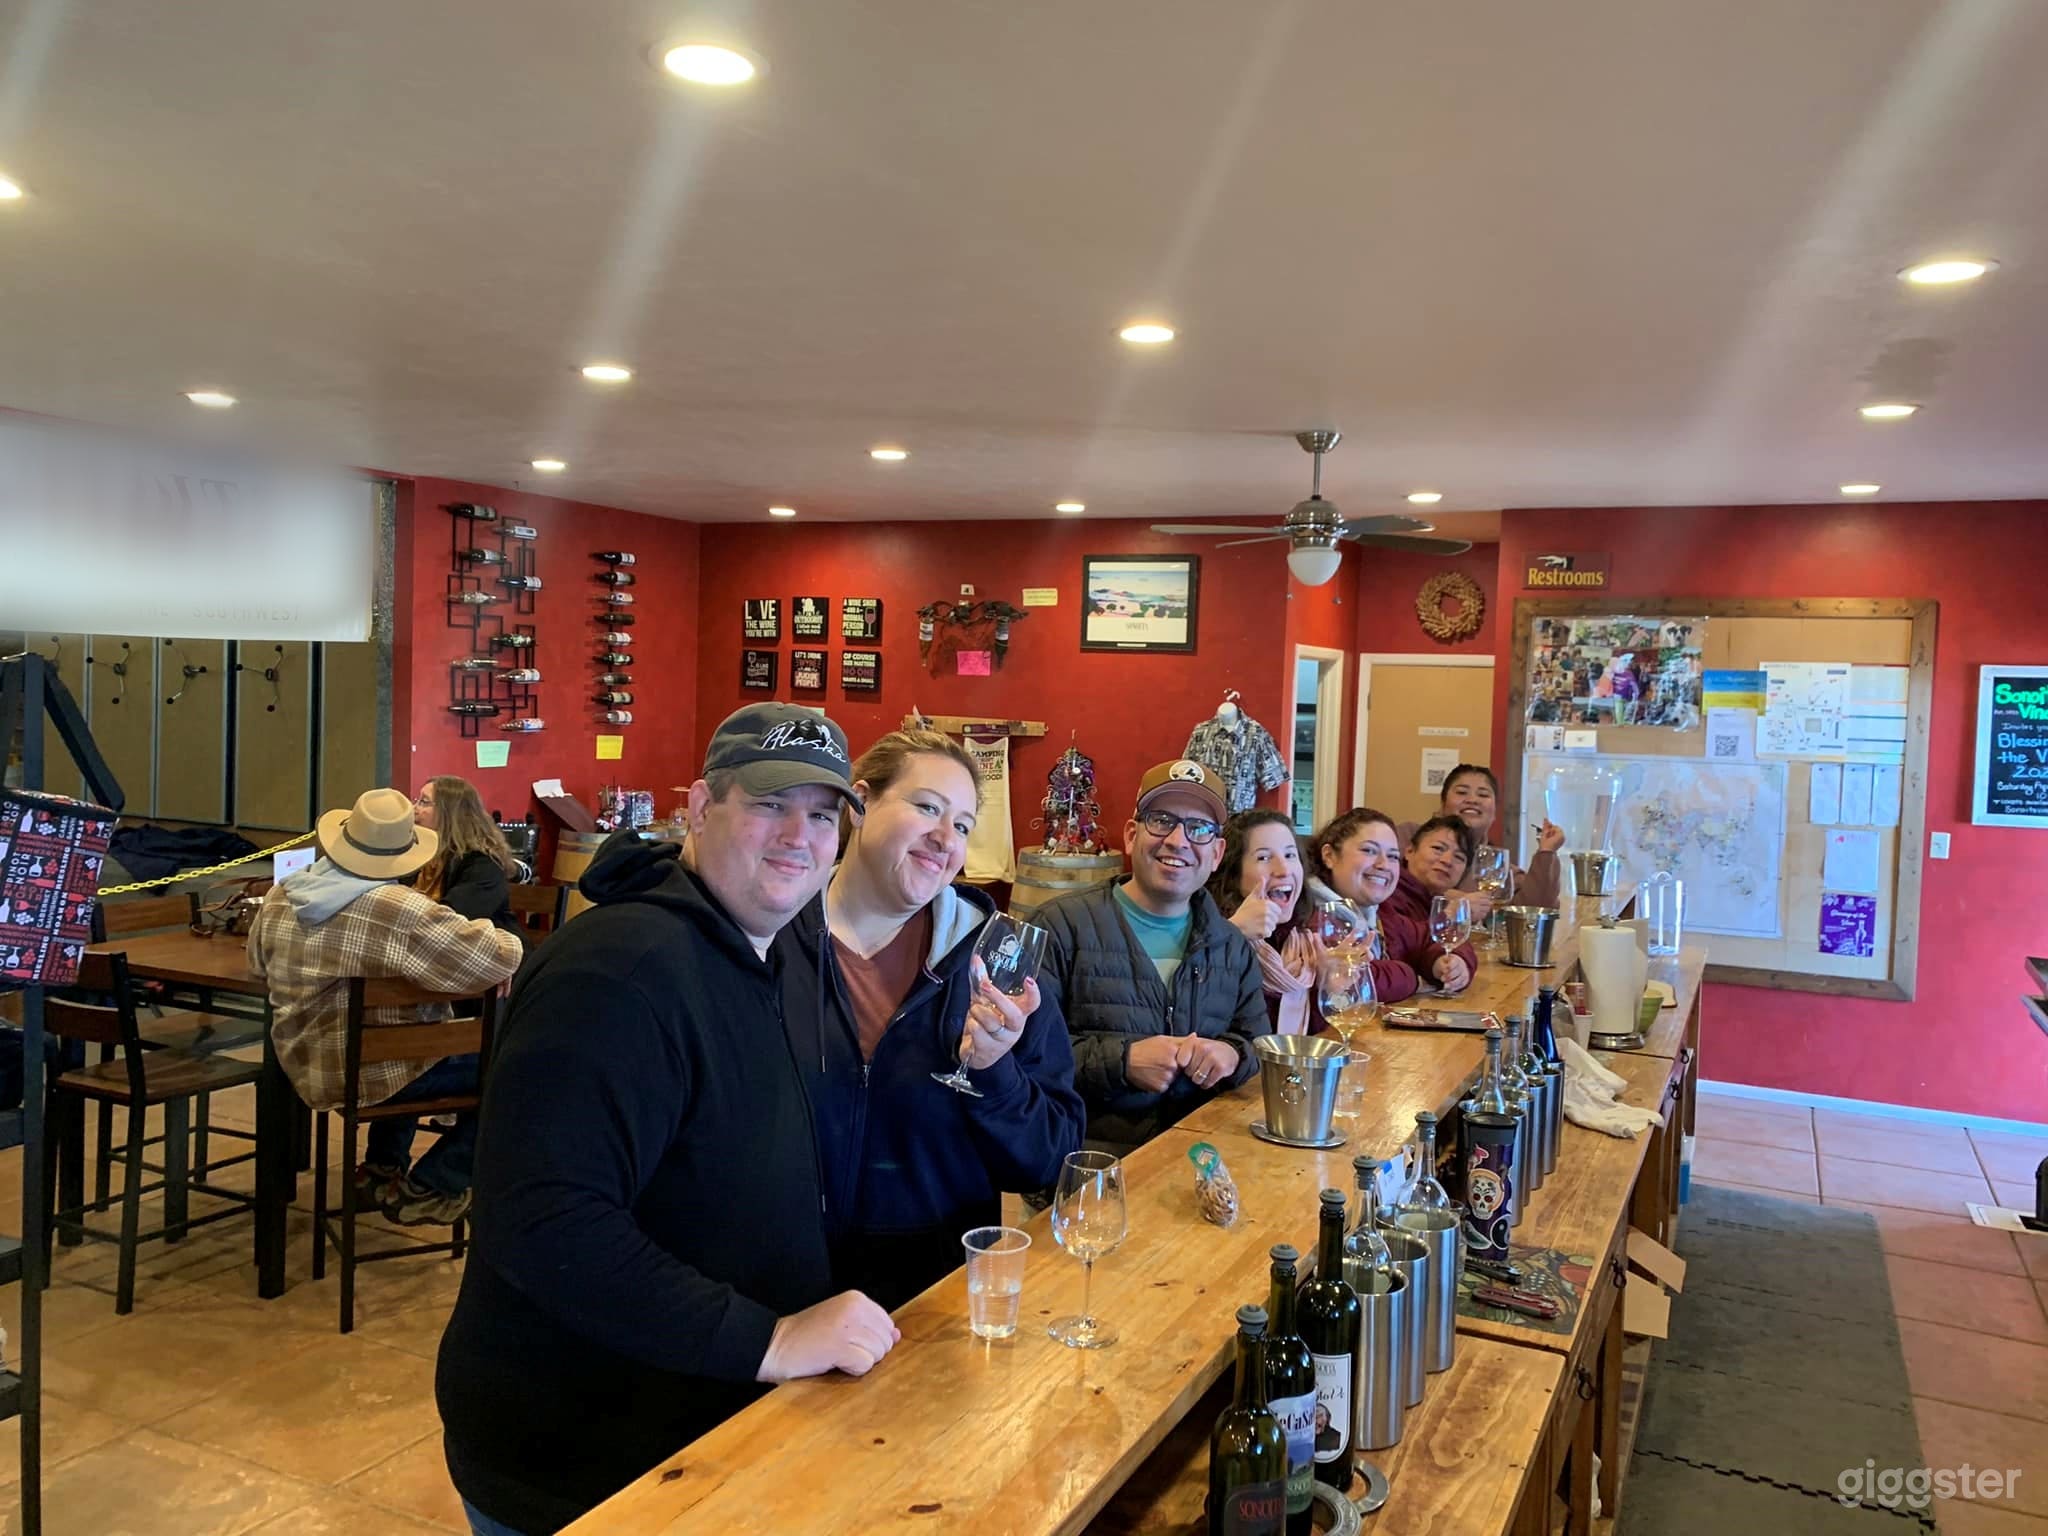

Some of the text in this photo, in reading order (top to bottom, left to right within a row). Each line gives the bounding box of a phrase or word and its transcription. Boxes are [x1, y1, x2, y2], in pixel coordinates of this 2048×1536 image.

[1528, 568, 1603, 585] Restrooms
[745, 600, 776, 619] LVE
[745, 620, 758, 628] THE
[761, 726, 846, 762] Alaska
[1997, 732, 2048, 749] Blessin
[1996, 751, 2029, 764] the
[6, 852, 21, 883] PINOT
[16, 853, 31, 884] NOIR
[55, 846, 71, 890] RIESLING
[37, 889, 52, 928] CABERNET
[45, 890, 60, 929] SAUVIGNON
[33, 936, 49, 980] RIESLING
